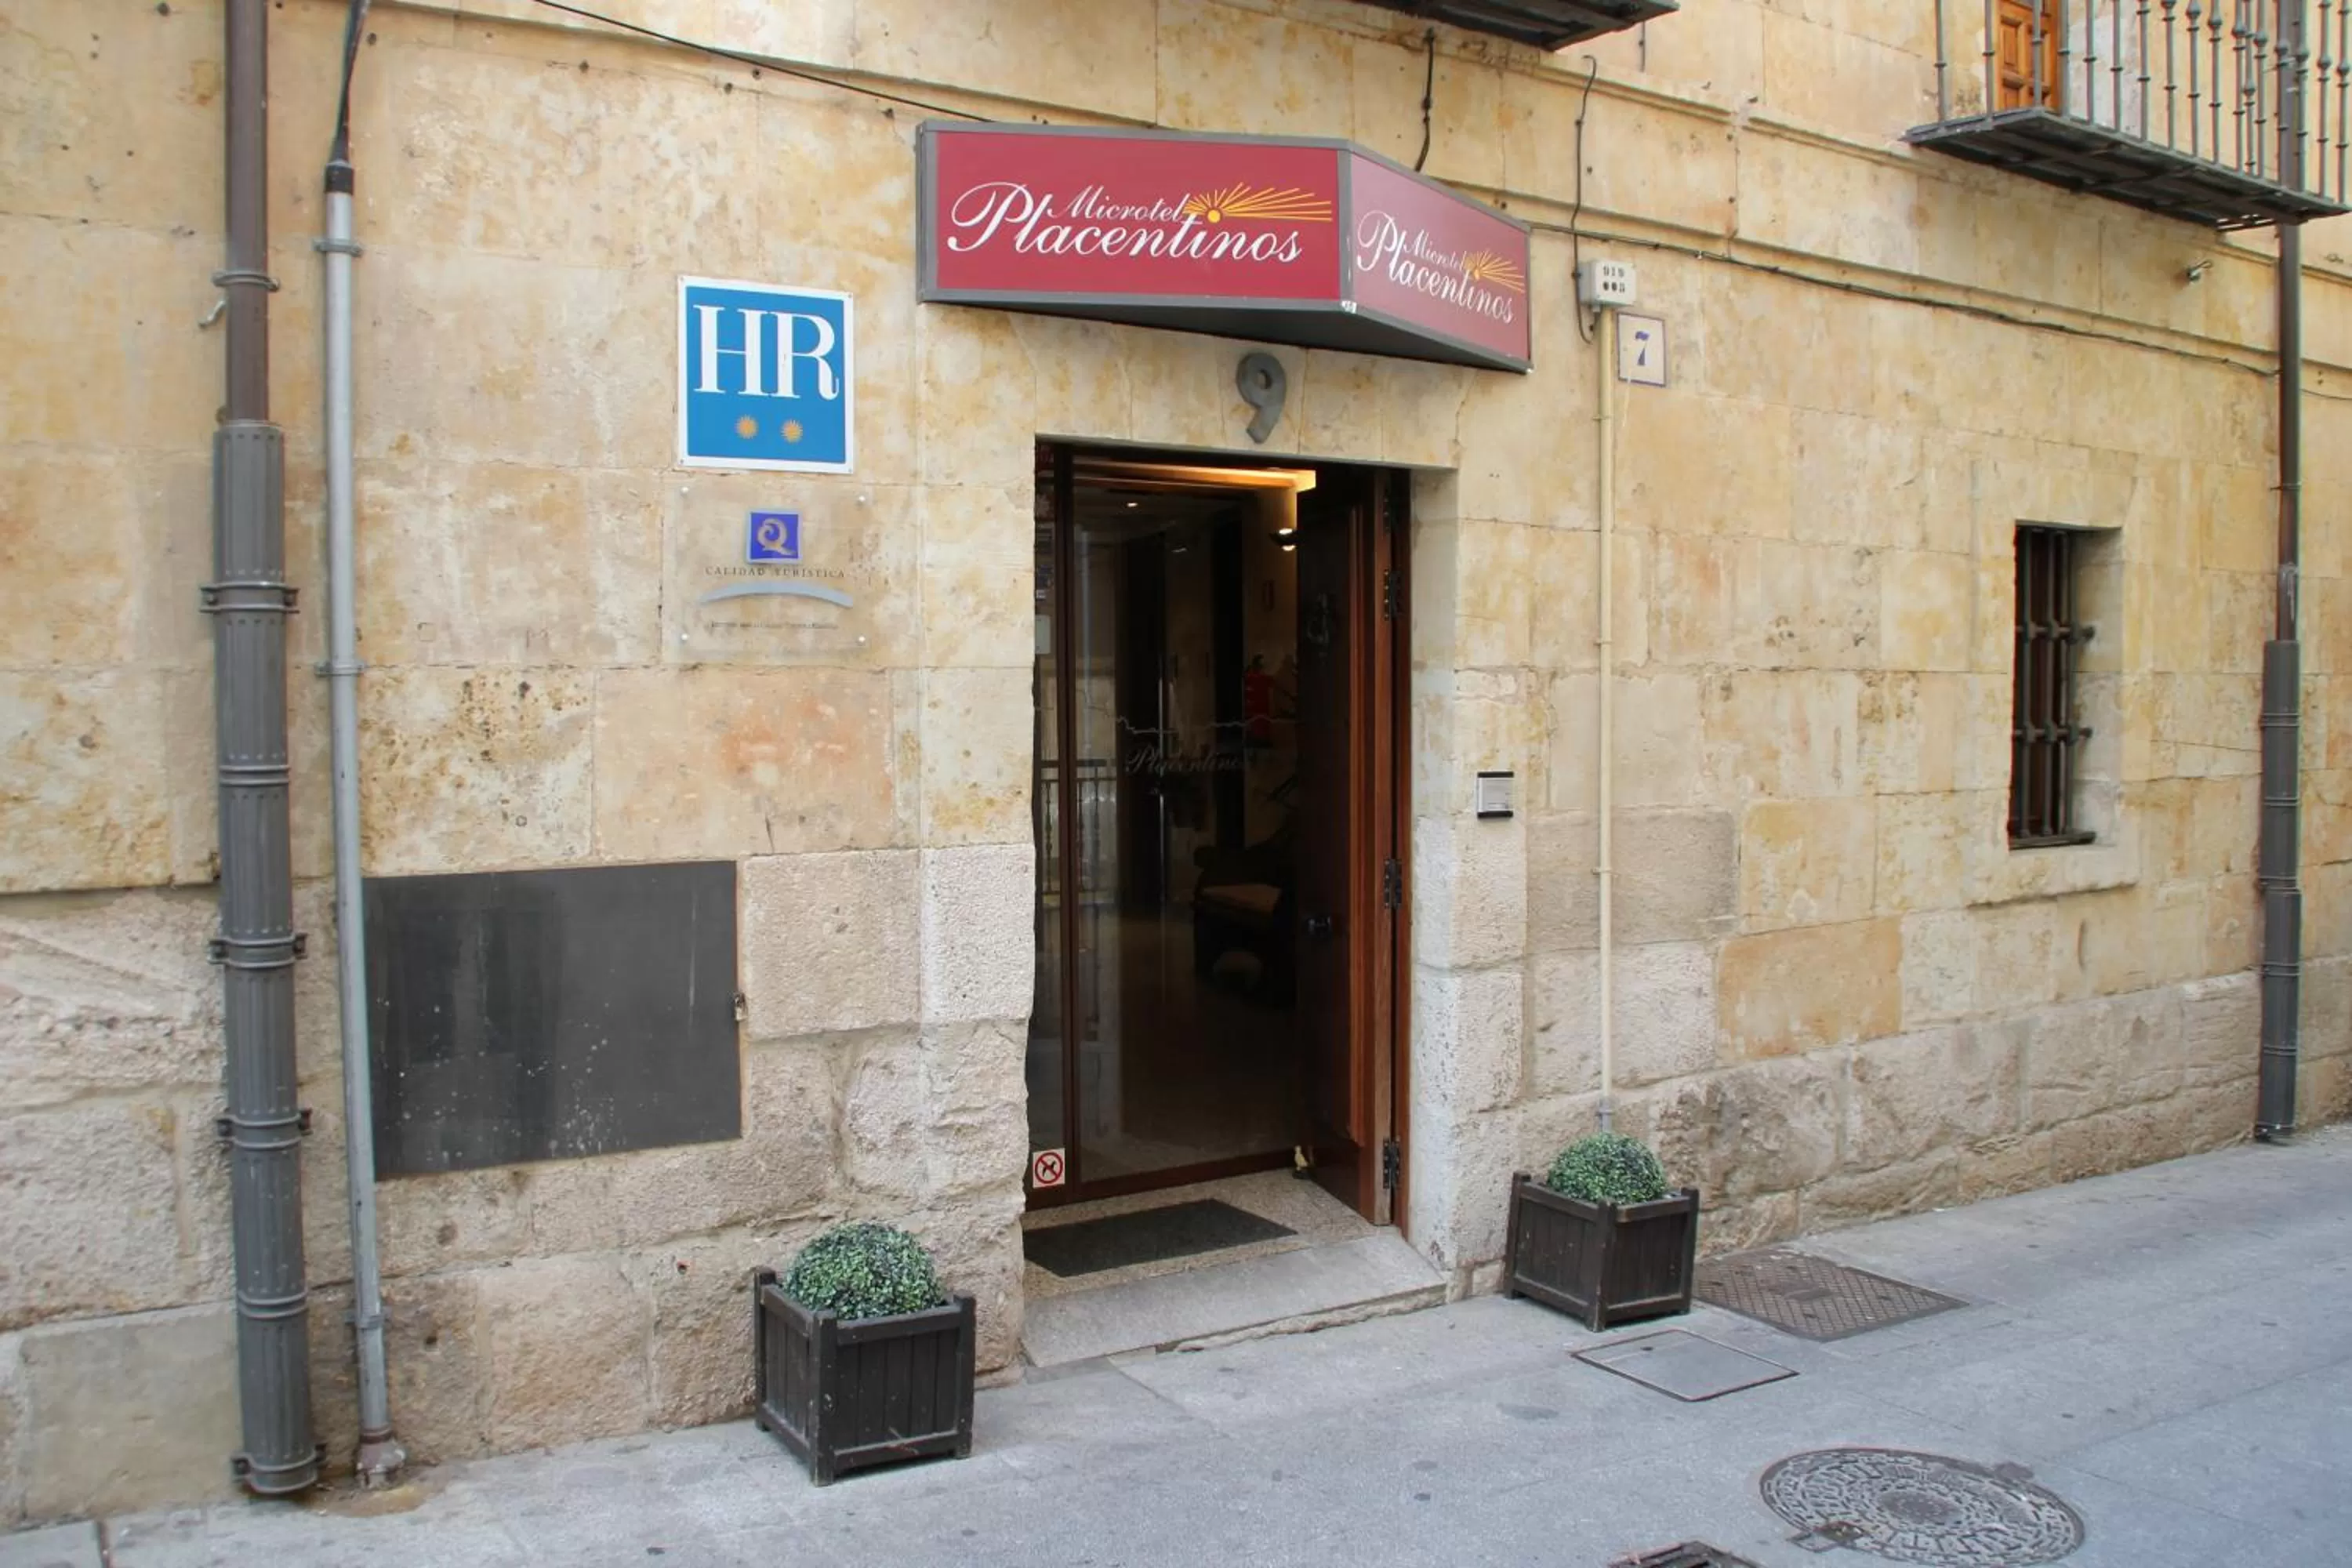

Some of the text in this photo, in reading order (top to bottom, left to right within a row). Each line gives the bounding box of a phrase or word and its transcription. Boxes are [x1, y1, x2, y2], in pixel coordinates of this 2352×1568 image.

[946, 181, 1303, 263] Placentinos
[1047, 184, 1191, 222] Microtel
[1356, 209, 1515, 324] Placentinos
[1403, 229, 1468, 271] Microtel
[692, 303, 840, 401] HR
[1635, 330, 1650, 366] 7
[1235, 352, 1287, 445] 9
[705, 566, 766, 577] CALIDAD
